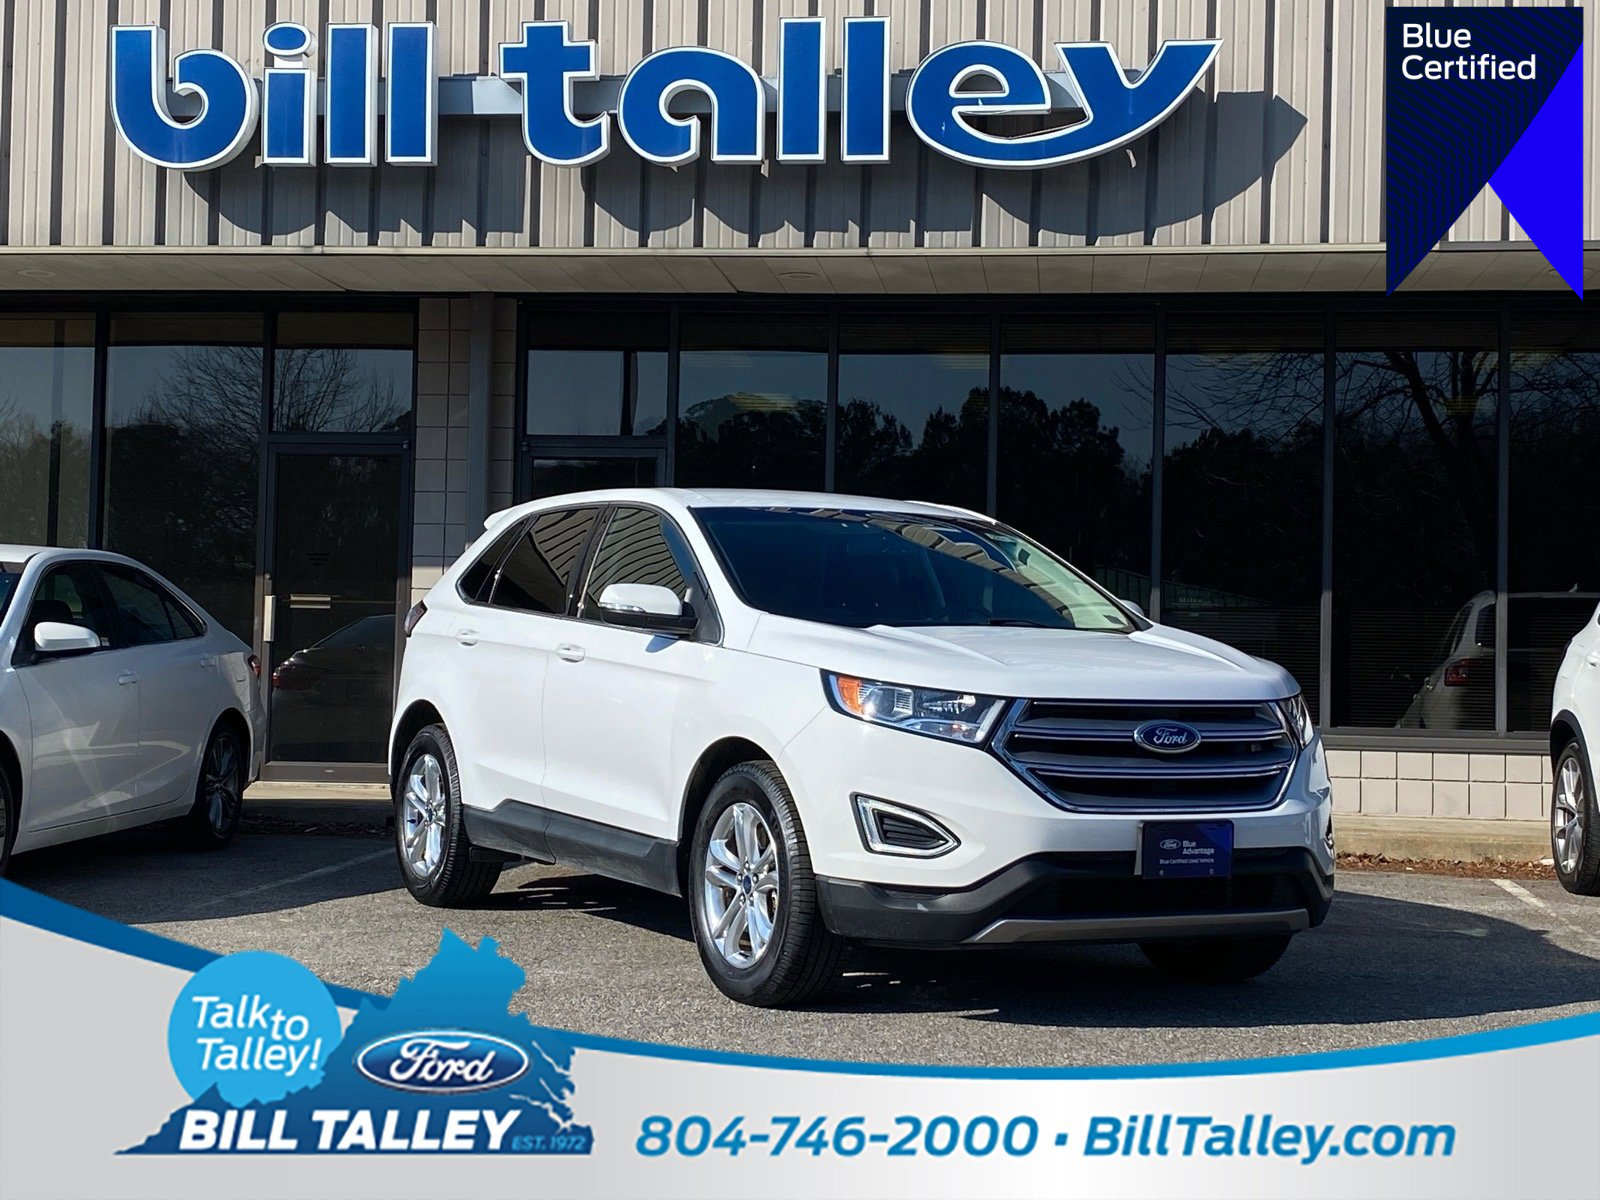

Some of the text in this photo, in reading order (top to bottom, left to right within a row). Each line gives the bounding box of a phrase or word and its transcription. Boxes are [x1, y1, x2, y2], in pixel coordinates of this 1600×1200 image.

[110, 16, 1224, 171] bill talley
[1152, 727, 1189, 745] Ford
[1182, 840, 1197, 848] Blue
[1182, 848, 1215, 856] Advantage
